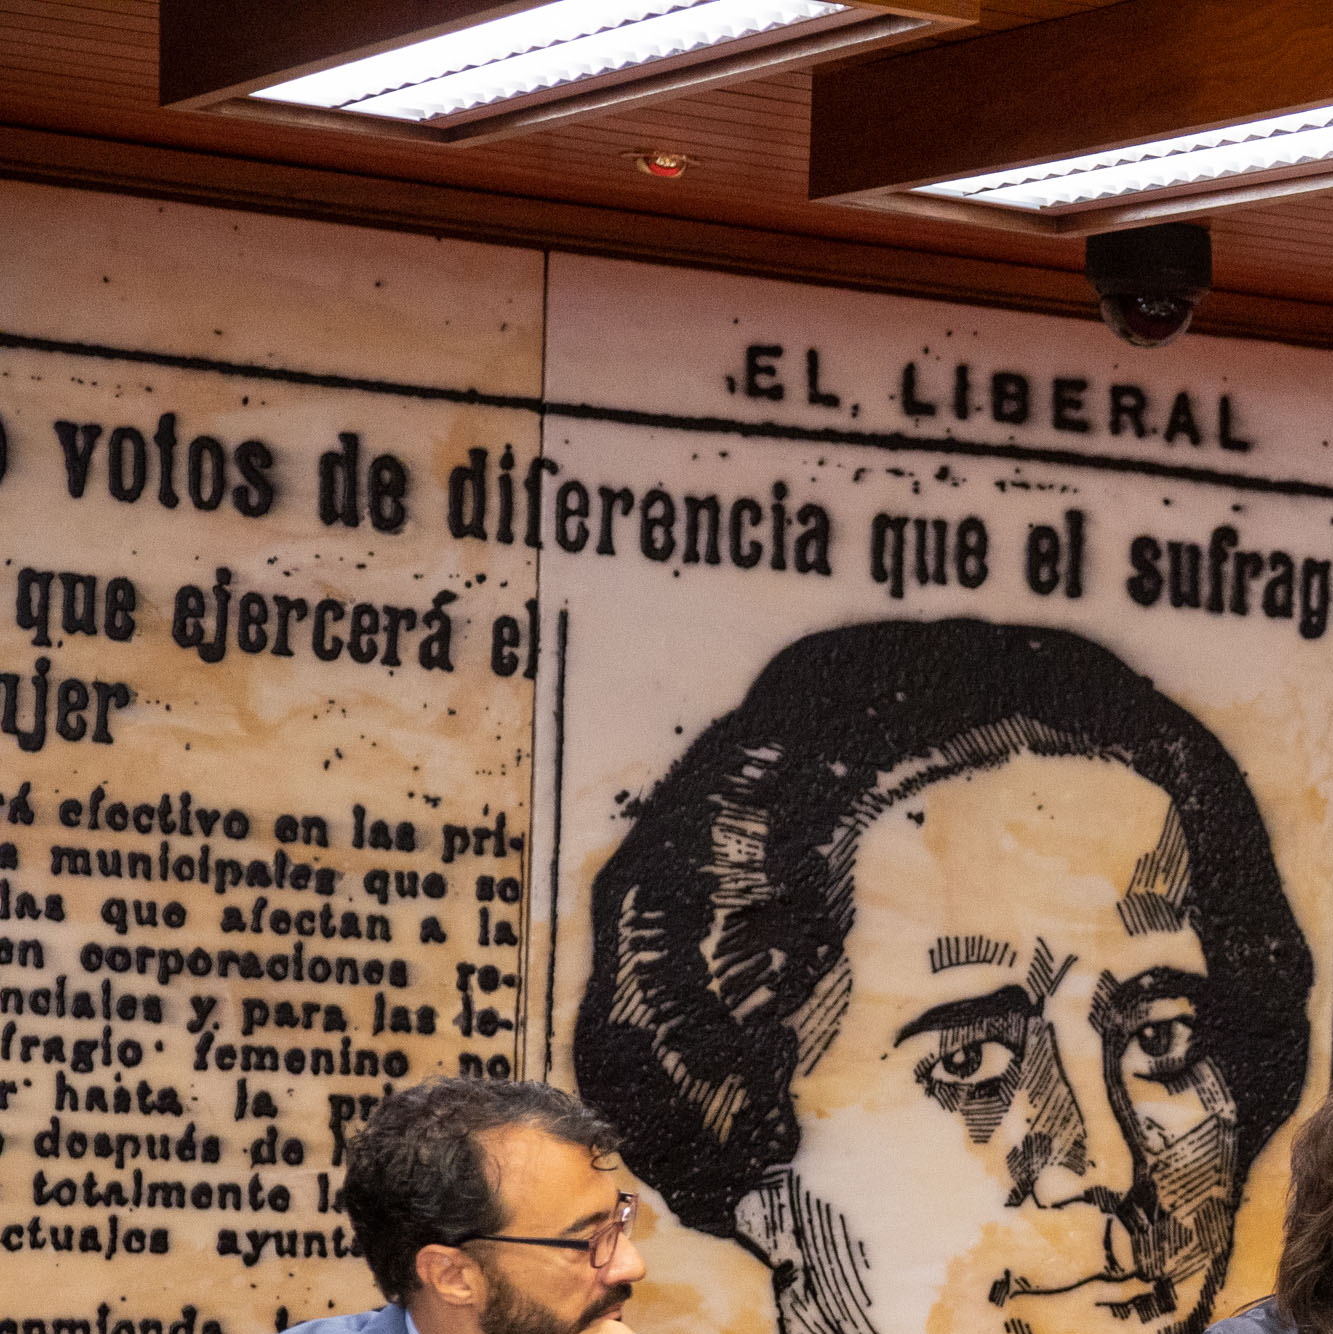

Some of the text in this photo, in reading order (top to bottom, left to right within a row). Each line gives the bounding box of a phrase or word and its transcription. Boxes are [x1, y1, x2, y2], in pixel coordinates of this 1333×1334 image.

[900, 359, 1253, 453] LIBERAL
[55, 412, 276, 519] votos
[319, 431, 409, 536] de
[449, 444, 831, 578] diferencia
[871, 510, 990, 600] que
[1026, 508, 1084, 599] el
[15, 566, 538, 681] que ejercerá el
[352, 803, 417, 852] las
[100, 897, 187, 935] que
[221, 897, 393, 943] afectan
[420, 917, 447, 944] a
[478, 906, 518, 947] la
[459, 1050, 513, 1078] no
